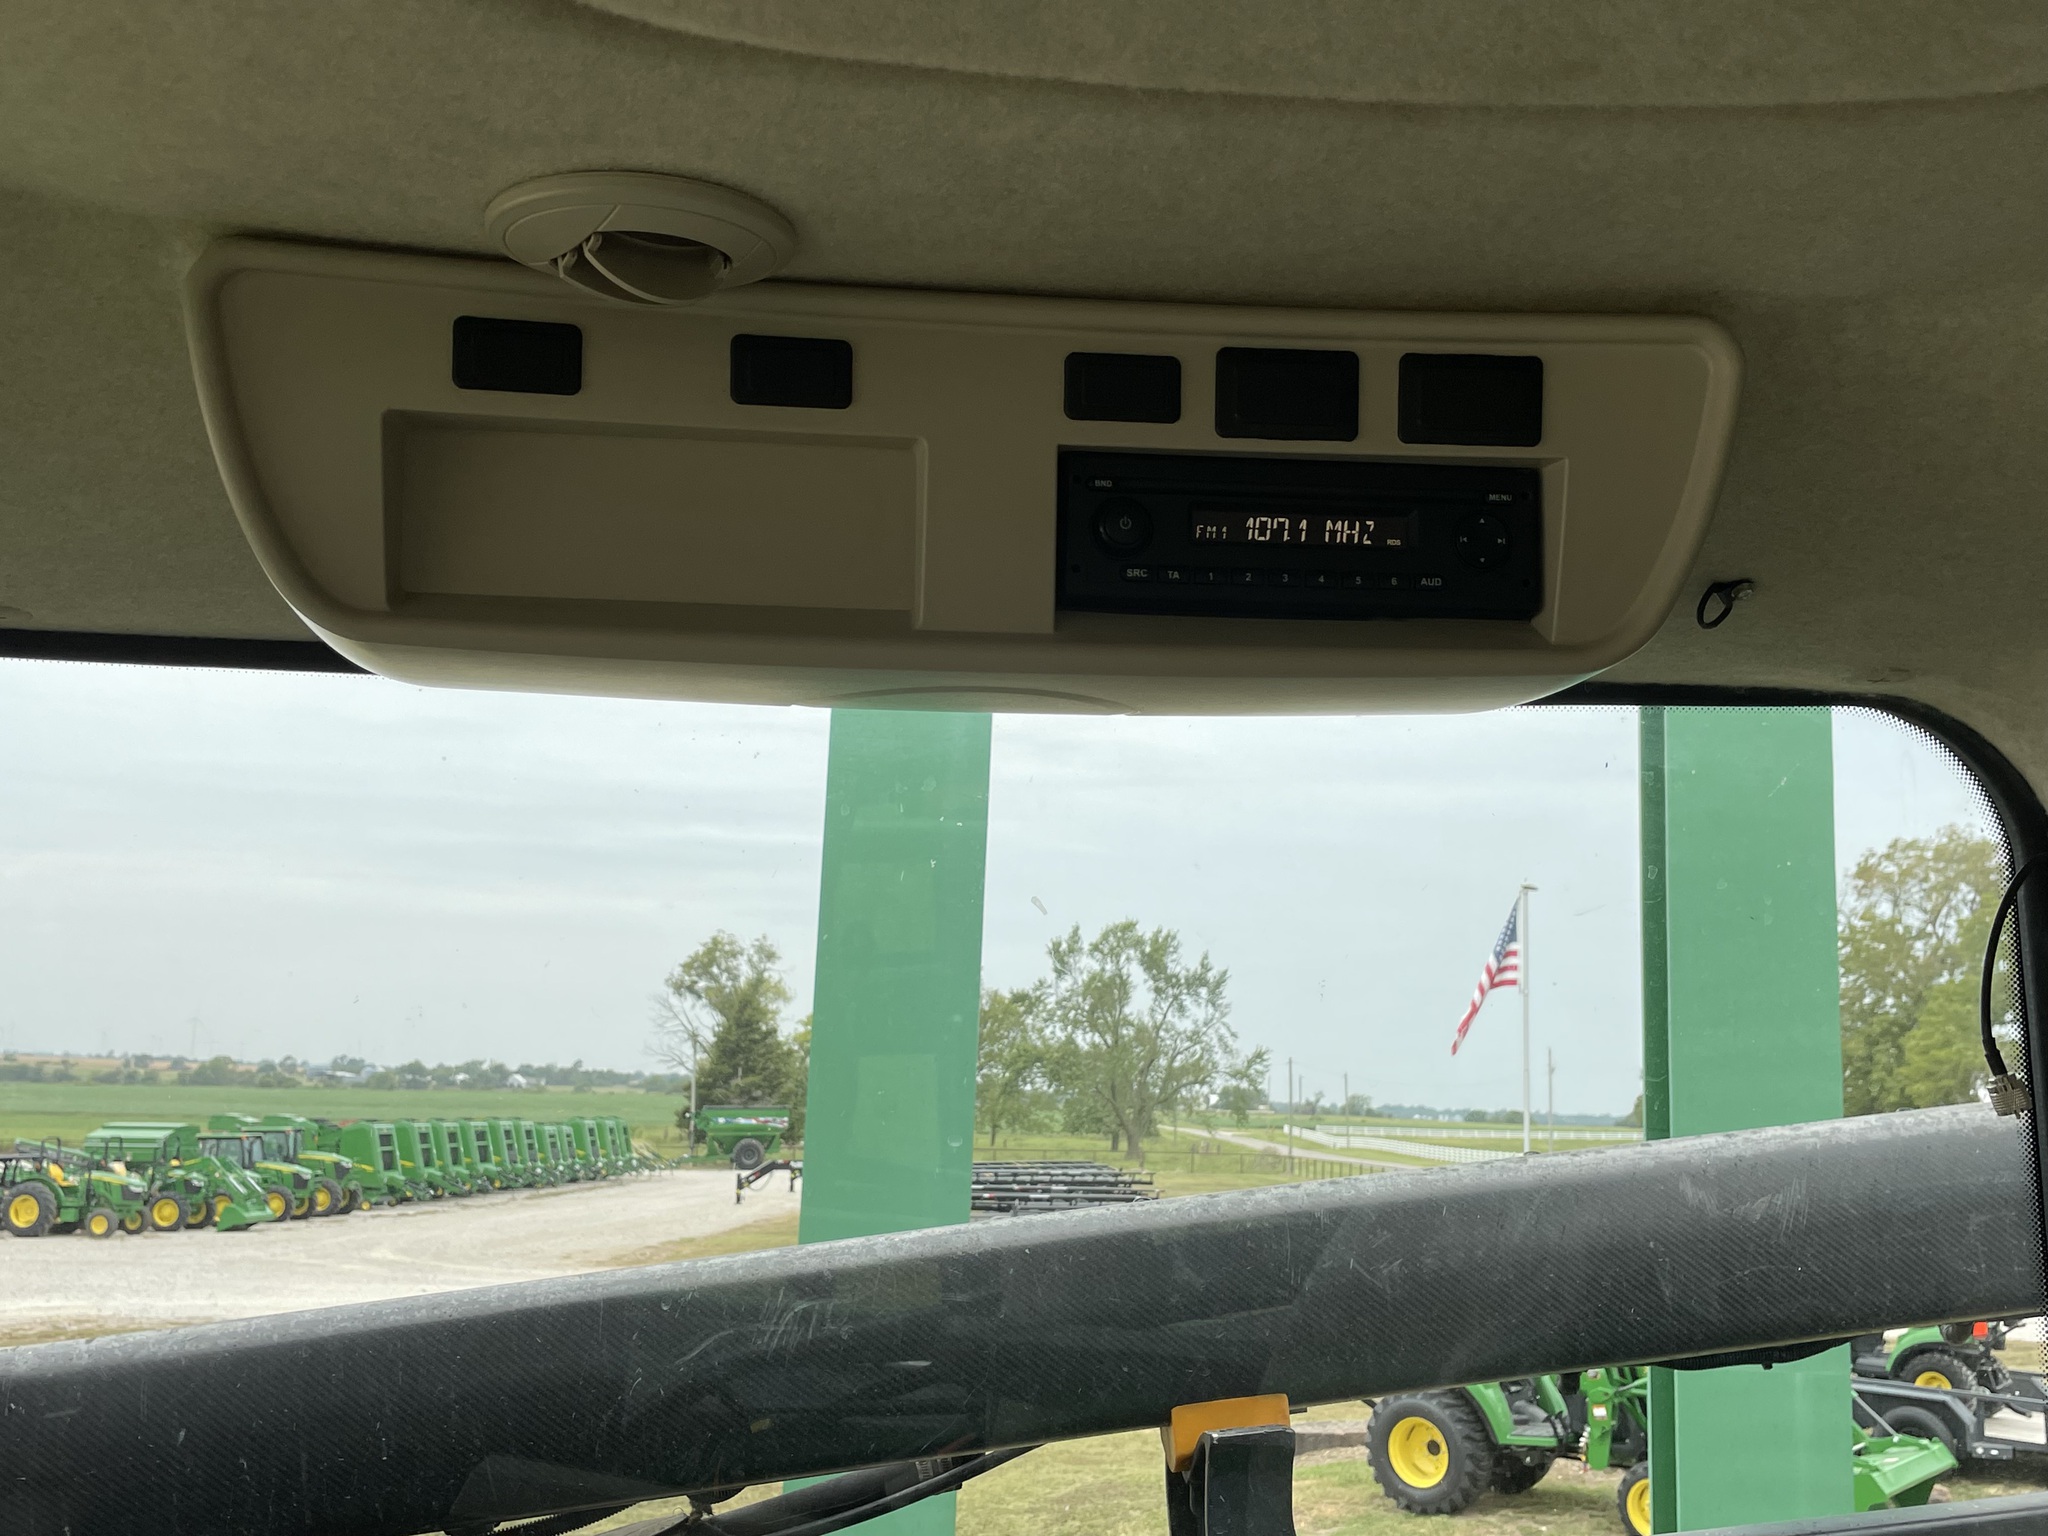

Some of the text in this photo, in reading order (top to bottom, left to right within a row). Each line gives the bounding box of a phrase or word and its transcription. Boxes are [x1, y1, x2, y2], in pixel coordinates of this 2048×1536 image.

[1094, 480, 1113, 488] BND
[1489, 493, 1513, 502] MENU
[1195, 524, 1227, 540] FM1
[1386, 538, 1402, 547] RDS
[1126, 568, 1149, 579] SRC
[1167, 570, 1181, 580] TA
[1420, 577, 1442, 587] AUD
